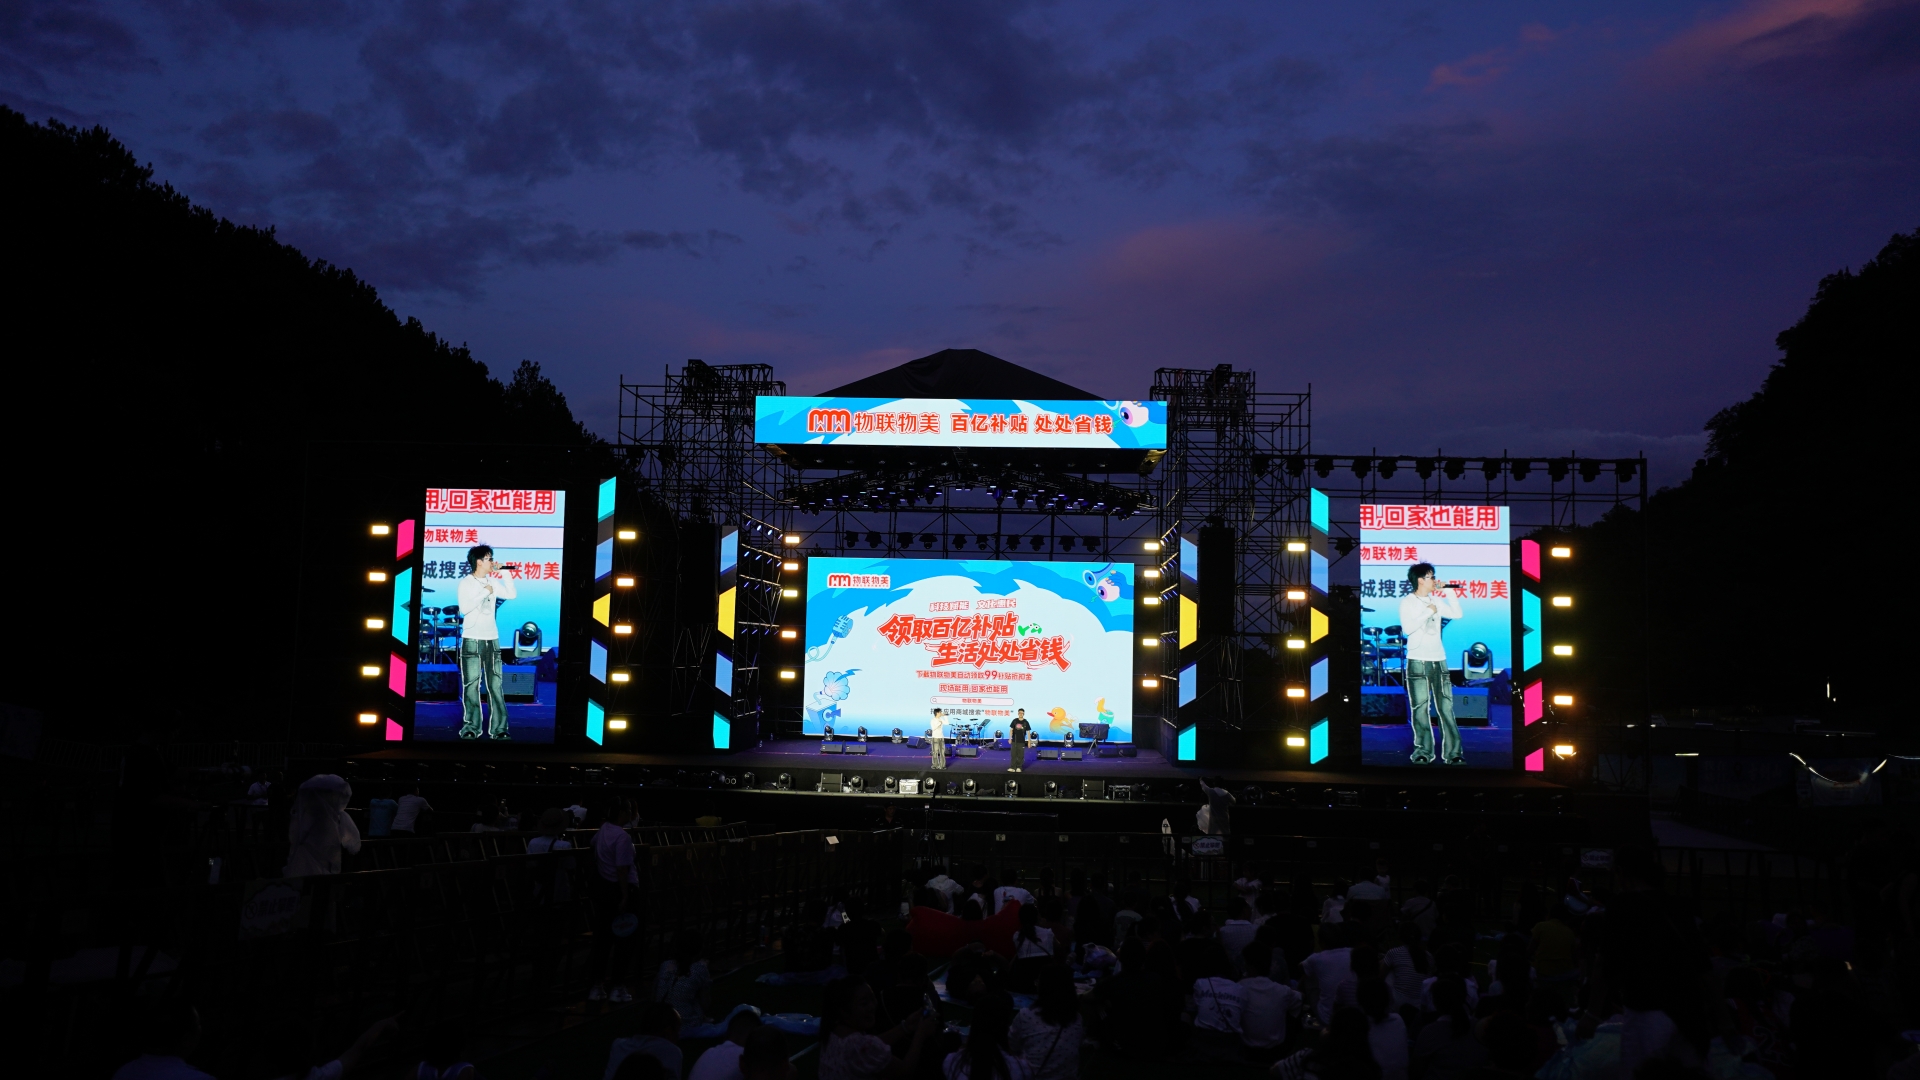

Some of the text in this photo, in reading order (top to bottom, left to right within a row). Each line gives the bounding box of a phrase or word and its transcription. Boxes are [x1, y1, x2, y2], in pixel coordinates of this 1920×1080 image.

[854, 411, 1112, 434] 物联物美 百亿补贴 处处省钱
[424, 529, 478, 543] 物联物美
[1360, 546, 1418, 561] 物联物美
[852, 576, 889, 584] 物联物美
[878, 611, 1018, 647] 领取百亿补贴
[931, 636, 1071, 671] 生活处处省钱
